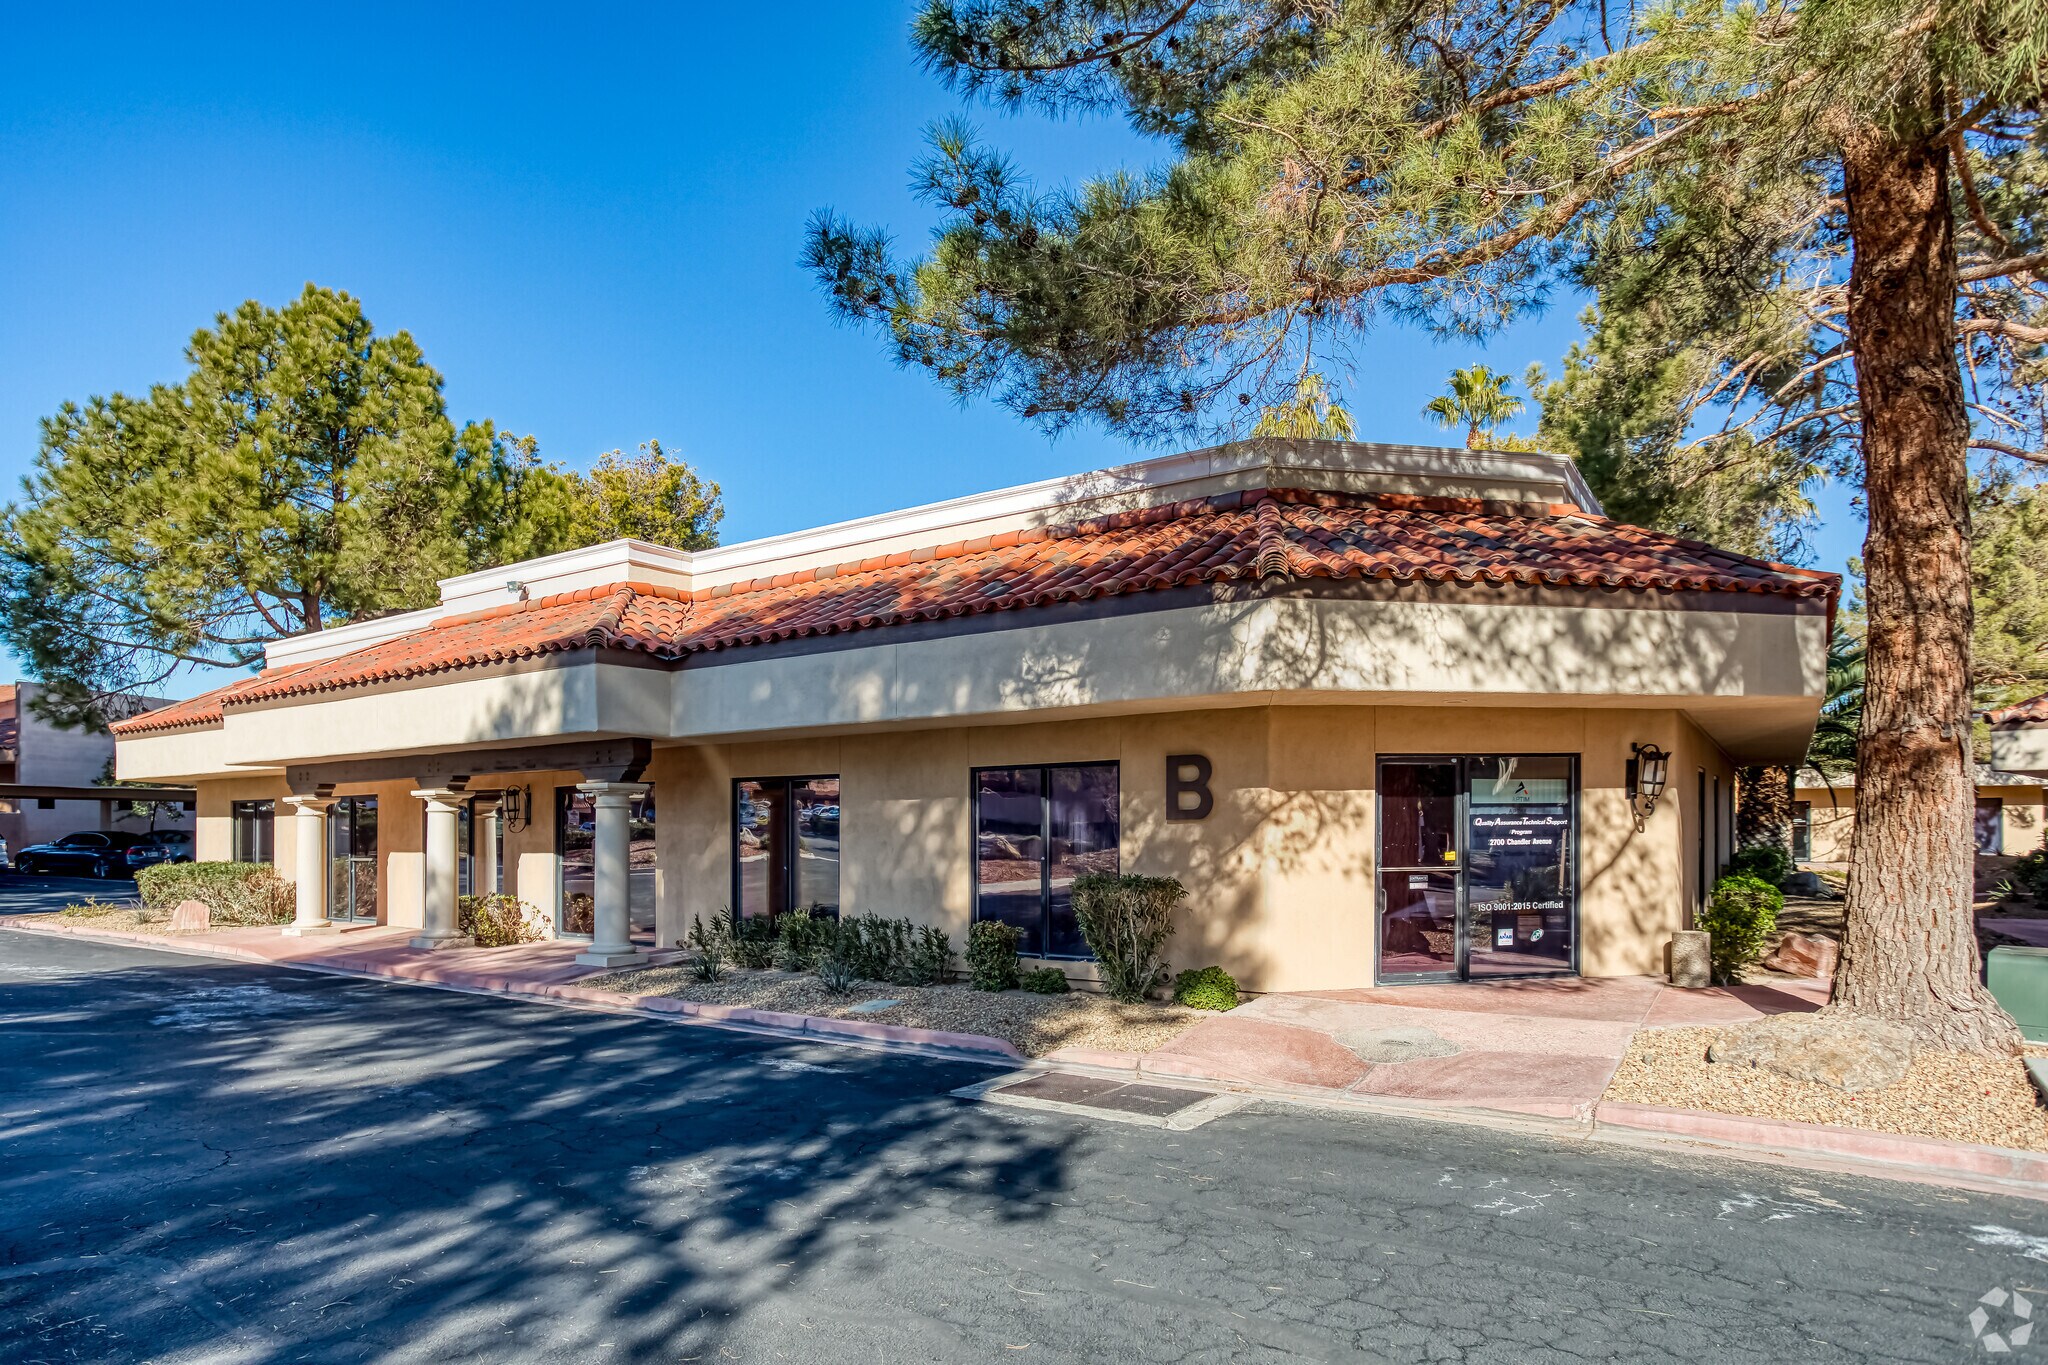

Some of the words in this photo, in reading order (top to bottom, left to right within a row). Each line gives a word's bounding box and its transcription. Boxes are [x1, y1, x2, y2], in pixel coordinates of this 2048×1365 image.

[1165, 754, 1213, 820] B
[1475, 818, 1494, 826] Quality
[1494, 817, 1522, 826] Assurance
[1522, 817, 1546, 826] Technical
[1546, 817, 1568, 826] Support
[1478, 903, 1492, 912] ISO
[1493, 902, 1530, 911] 9001:2015
[1532, 900, 1564, 910] Certified
